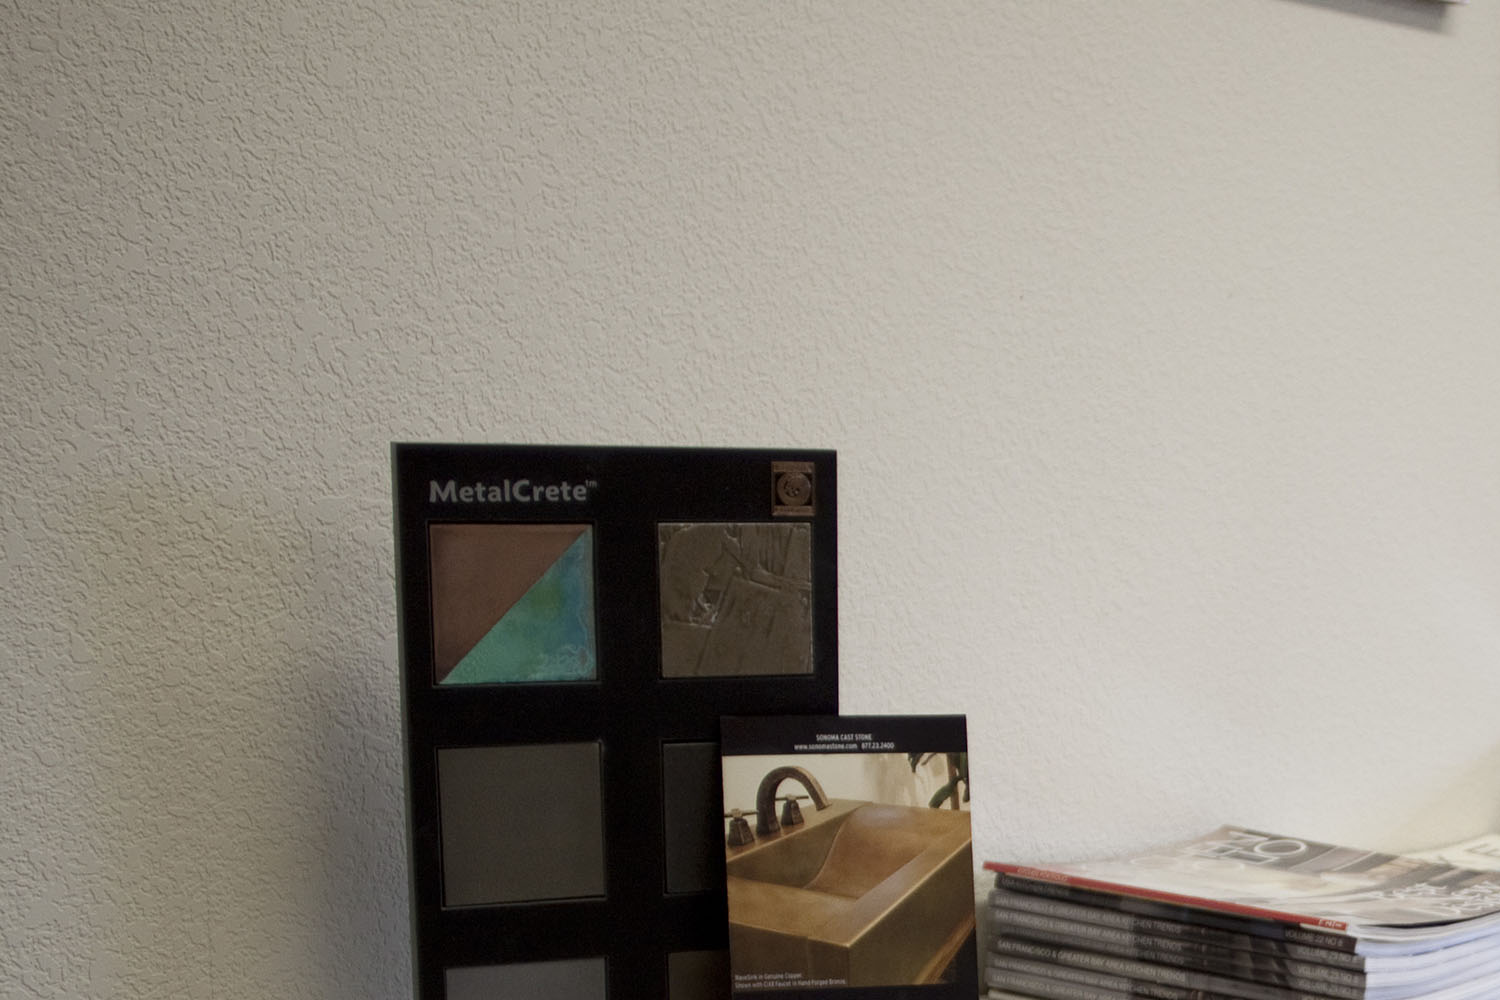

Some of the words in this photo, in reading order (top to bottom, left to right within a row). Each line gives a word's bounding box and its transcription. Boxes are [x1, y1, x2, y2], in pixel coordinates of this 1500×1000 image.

[816, 733, 839, 741] SONOMA
[841, 733, 854, 741] CAST
[855, 733, 872, 741] STONE
[994, 908, 1008, 920] SAN
[1009, 911, 1049, 928] FRANCISCO
[1087, 925, 1101, 937] BAY
[1103, 928, 1121, 941] AREA
[1122, 931, 1152, 946] KITCHEN
[1154, 937, 1182, 952] TRENDS
[1087, 910, 1101, 921] BAY
[1102, 912, 1121, 924] AREA
[1122, 915, 1152, 929] KITCHEN
[1152, 920, 1182, 934] TRENDS
[1285, 929, 1315, 943] VOLUME
[1325, 936, 1336, 947] NO
[997, 939, 1012, 951] SAN
[1057, 949, 1090, 965] GREATER
[1090, 955, 1105, 968] BAY
[1106, 958, 1125, 971] AREA
[1125, 962, 1156, 977] KITCHEN
[1157, 967, 1186, 982] TRENDS
[1298, 964, 1328, 979] VOLUME
[992, 972, 1007, 984] SAN
[1007, 975, 1045, 992] FRANCISCO
[1052, 984, 1083, 999] GREATER
[994, 957, 1008, 969] SAN
[1008, 960, 1047, 976] FRANCISCO
[1085, 974, 1099, 986] BAY
[1100, 977, 1118, 990] AREA
[1118, 981, 1149, 996] KITCHEN
[1149, 986, 1178, 1000] TRENDS
